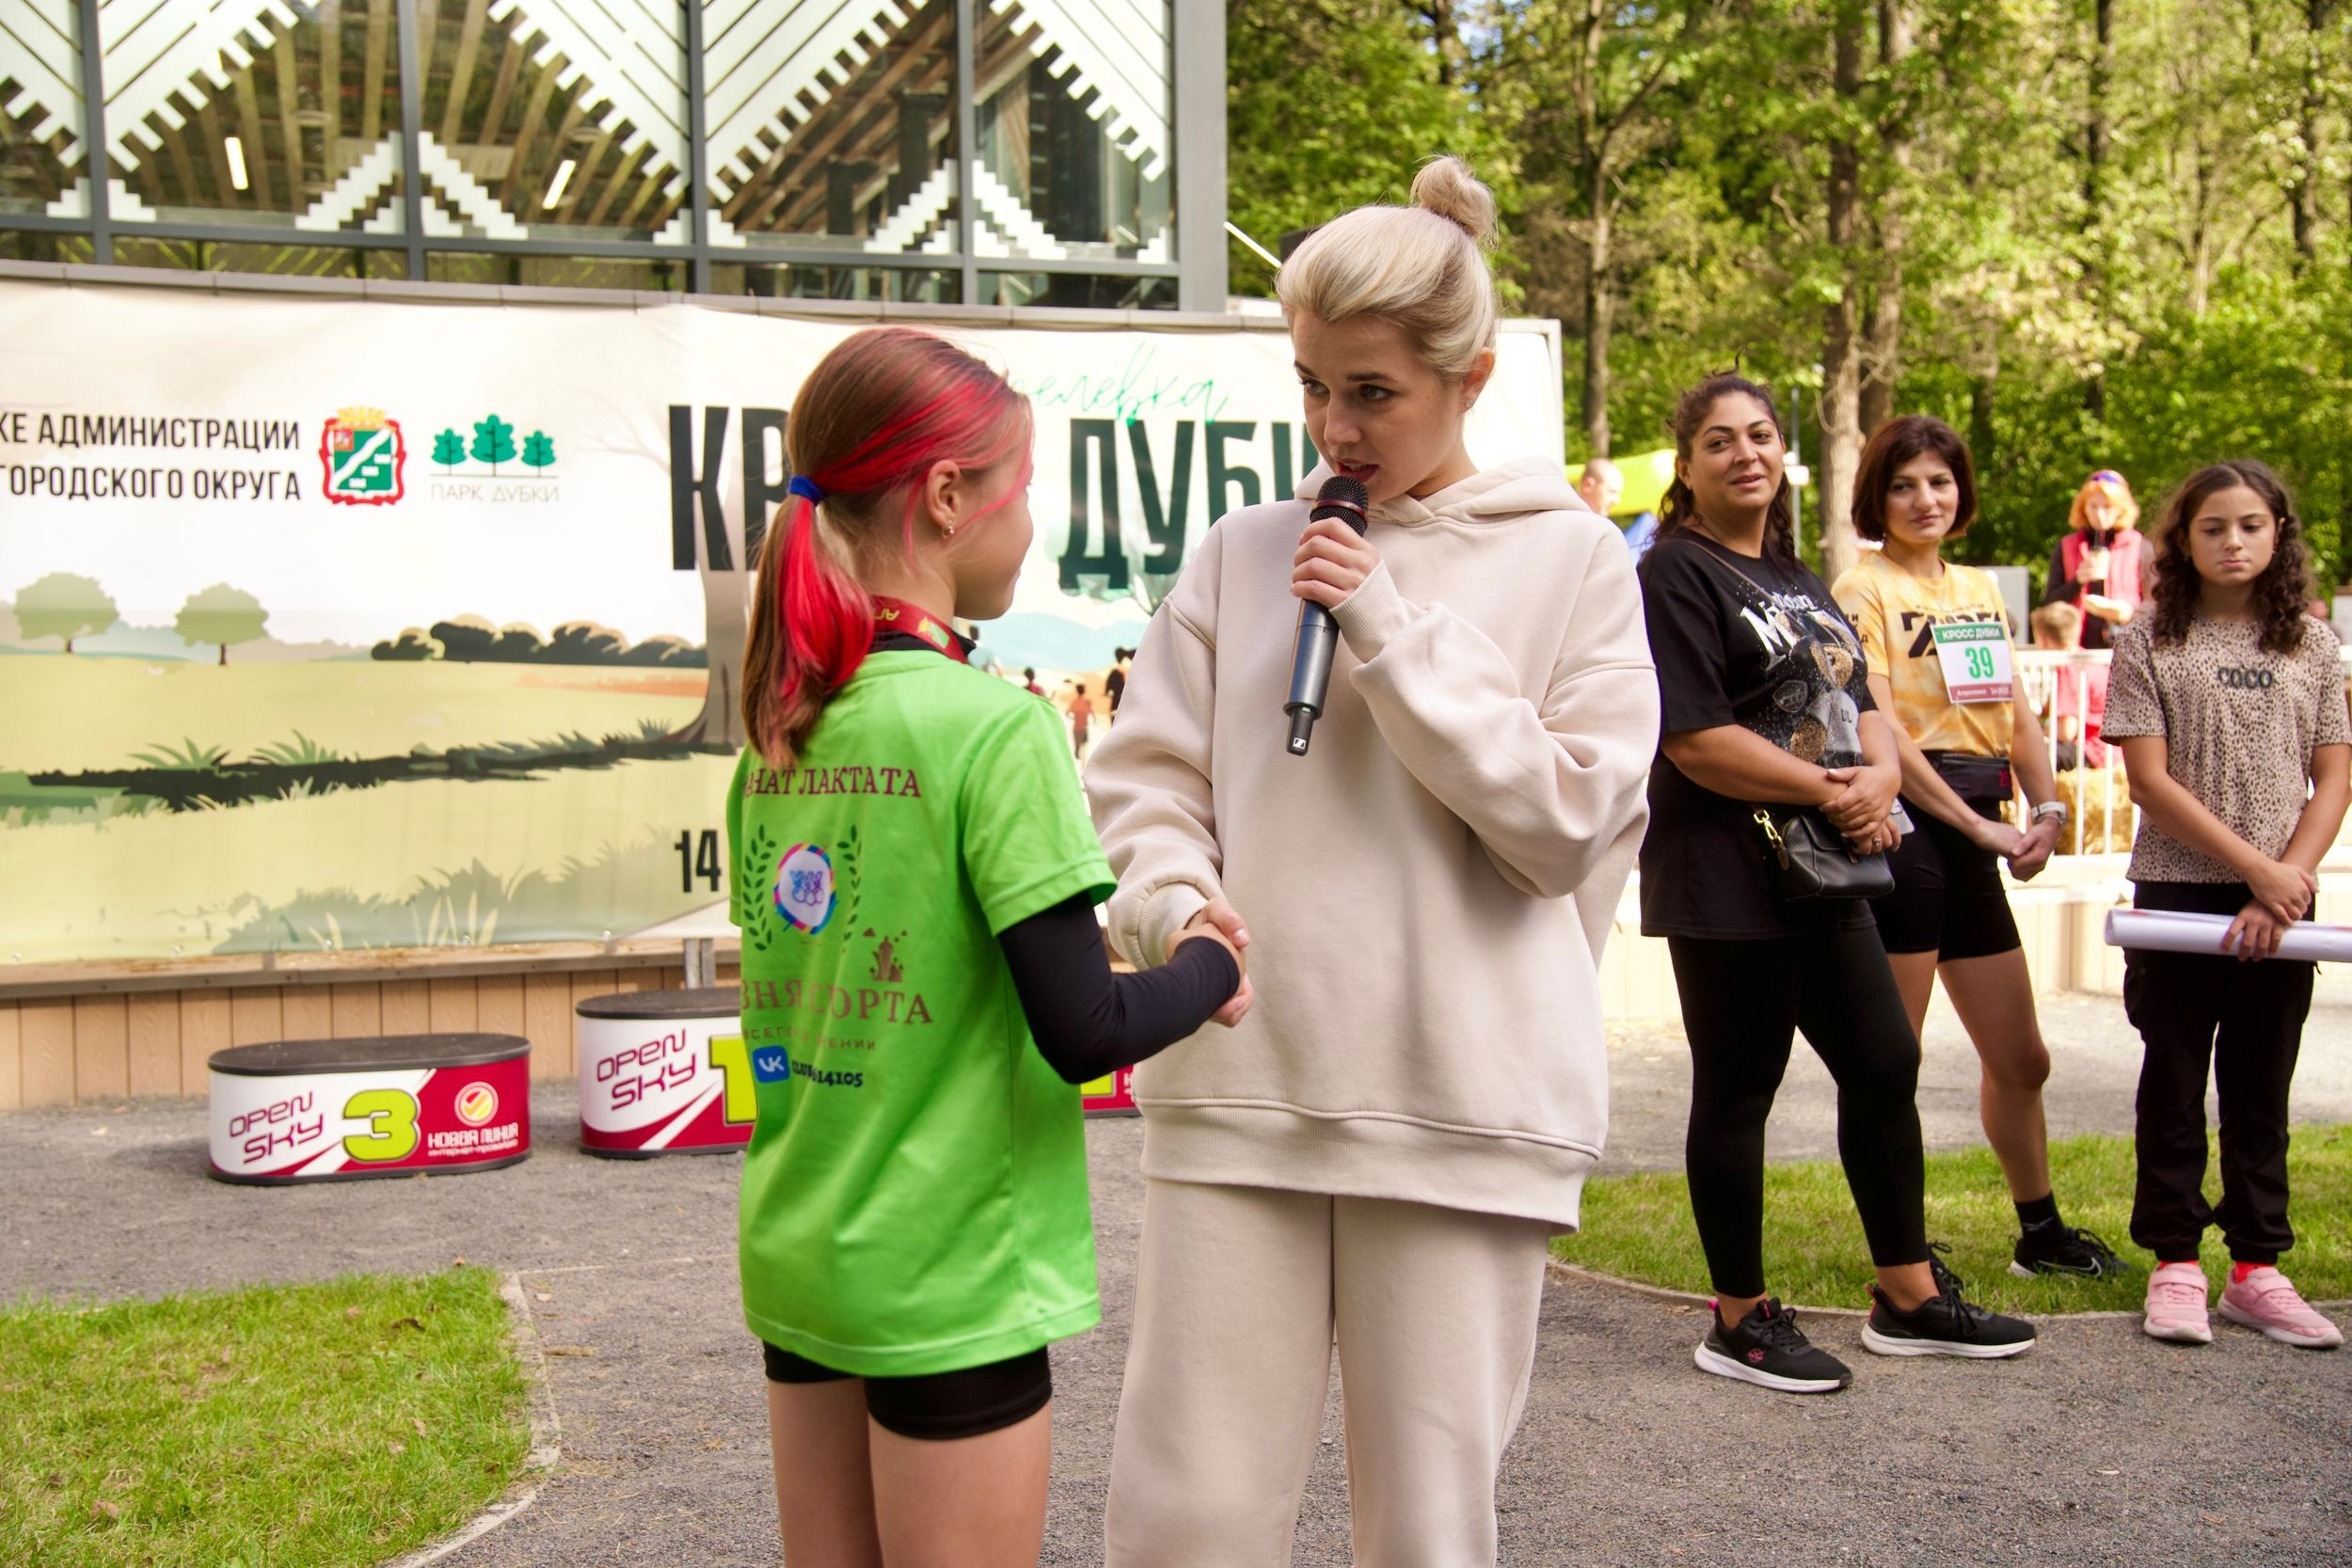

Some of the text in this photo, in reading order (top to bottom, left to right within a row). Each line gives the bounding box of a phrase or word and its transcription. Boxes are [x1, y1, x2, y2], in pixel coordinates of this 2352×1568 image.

[38, 414, 299, 453] АДМИНИСТРАЦИИ
[194, 469, 301, 500] ОКРУГА
[430, 483, 559, 502] ПАРК ДУБКИ
[1942, 628, 1975, 641] КРОСС
[1964, 645, 1994, 679] 39
[2218, 667, 2273, 689] COCO
[799, 766, 922, 798] ЛАКТАТА
[675, 829, 722, 894] 14
[611, 1053, 696, 1111] SKY
[243, 1114, 324, 1164] SKY
[342, 1088, 420, 1163] 3
